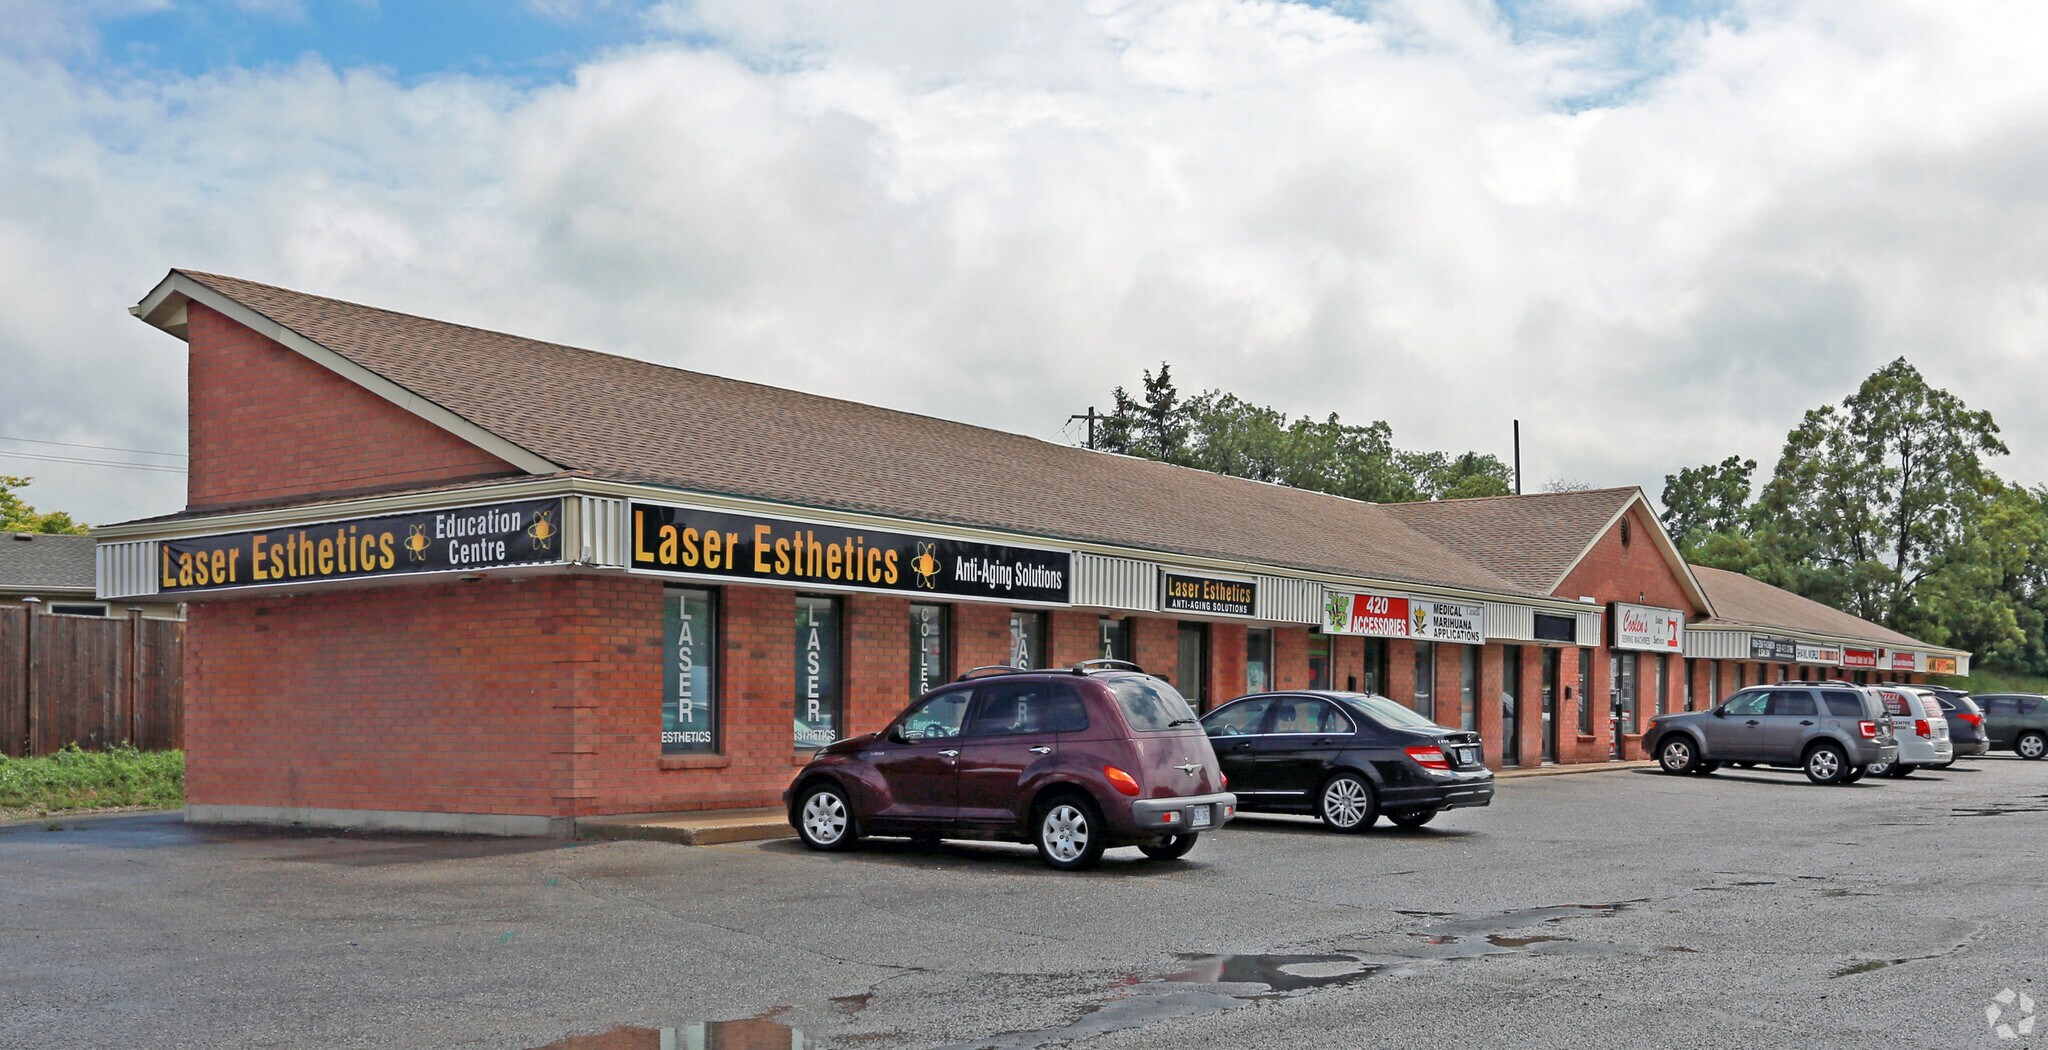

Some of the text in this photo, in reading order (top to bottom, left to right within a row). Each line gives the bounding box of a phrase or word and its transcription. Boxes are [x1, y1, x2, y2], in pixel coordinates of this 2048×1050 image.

[436, 509, 521, 539] Education
[163, 525, 395, 588] Laser Esthetics
[448, 538, 506, 565] Centre
[635, 510, 899, 585] Laser Esthetics
[955, 556, 1062, 590] Anti-Aging Solutions
[1168, 577, 1251, 603] Laser Esthetics
[1171, 599, 1248, 614] ANTI-AGING SOLUTIONS
[1366, 596, 1389, 615] 420
[1433, 603, 1462, 617] MEDICAL
[1352, 616, 1407, 636] ACCESSORIES
[1433, 616, 1473, 631] MARIHUANA
[1433, 628, 1480, 642] APPLICATIONS
[678, 595, 693, 723] LASER
[807, 603, 821, 722] LASER
[661, 731, 711, 743] ESTHETICS
